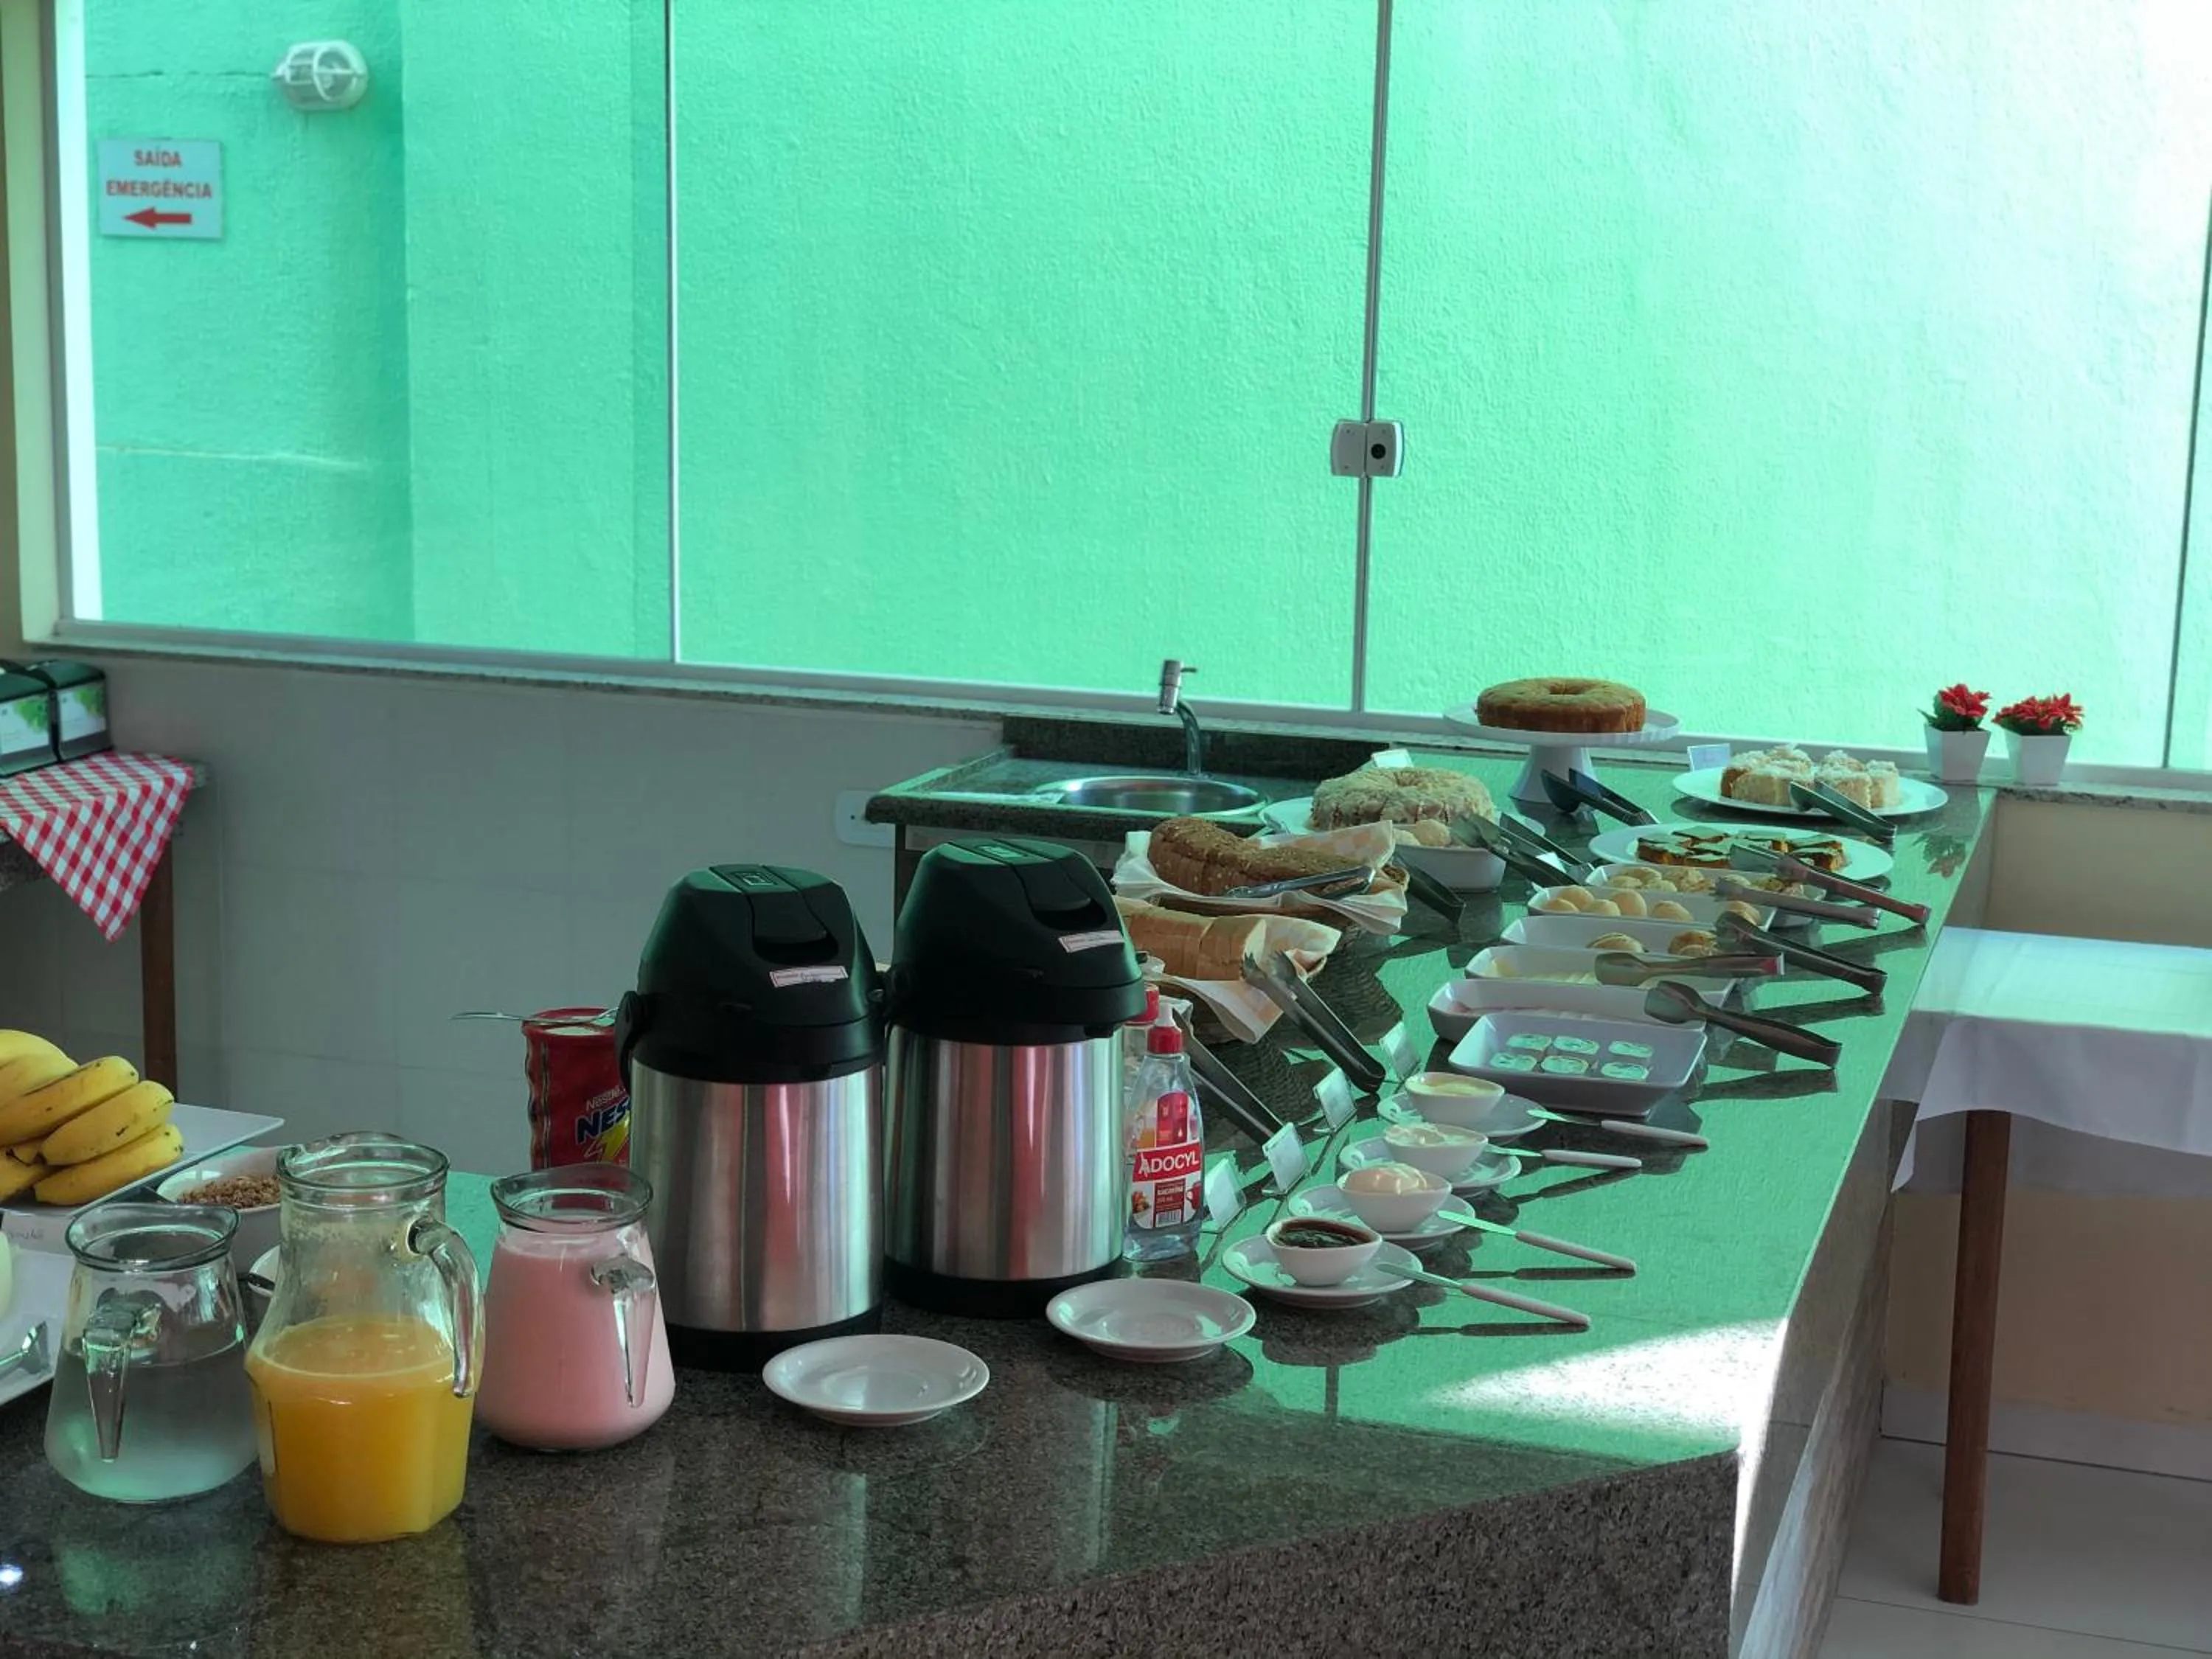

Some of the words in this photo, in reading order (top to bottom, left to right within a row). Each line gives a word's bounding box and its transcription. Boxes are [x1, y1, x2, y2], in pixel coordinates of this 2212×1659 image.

[134, 147, 181, 167] SAÍDA
[106, 179, 212, 198] EMERGÊNCIA
[1138, 1150, 1199, 1178] ADOCYL
